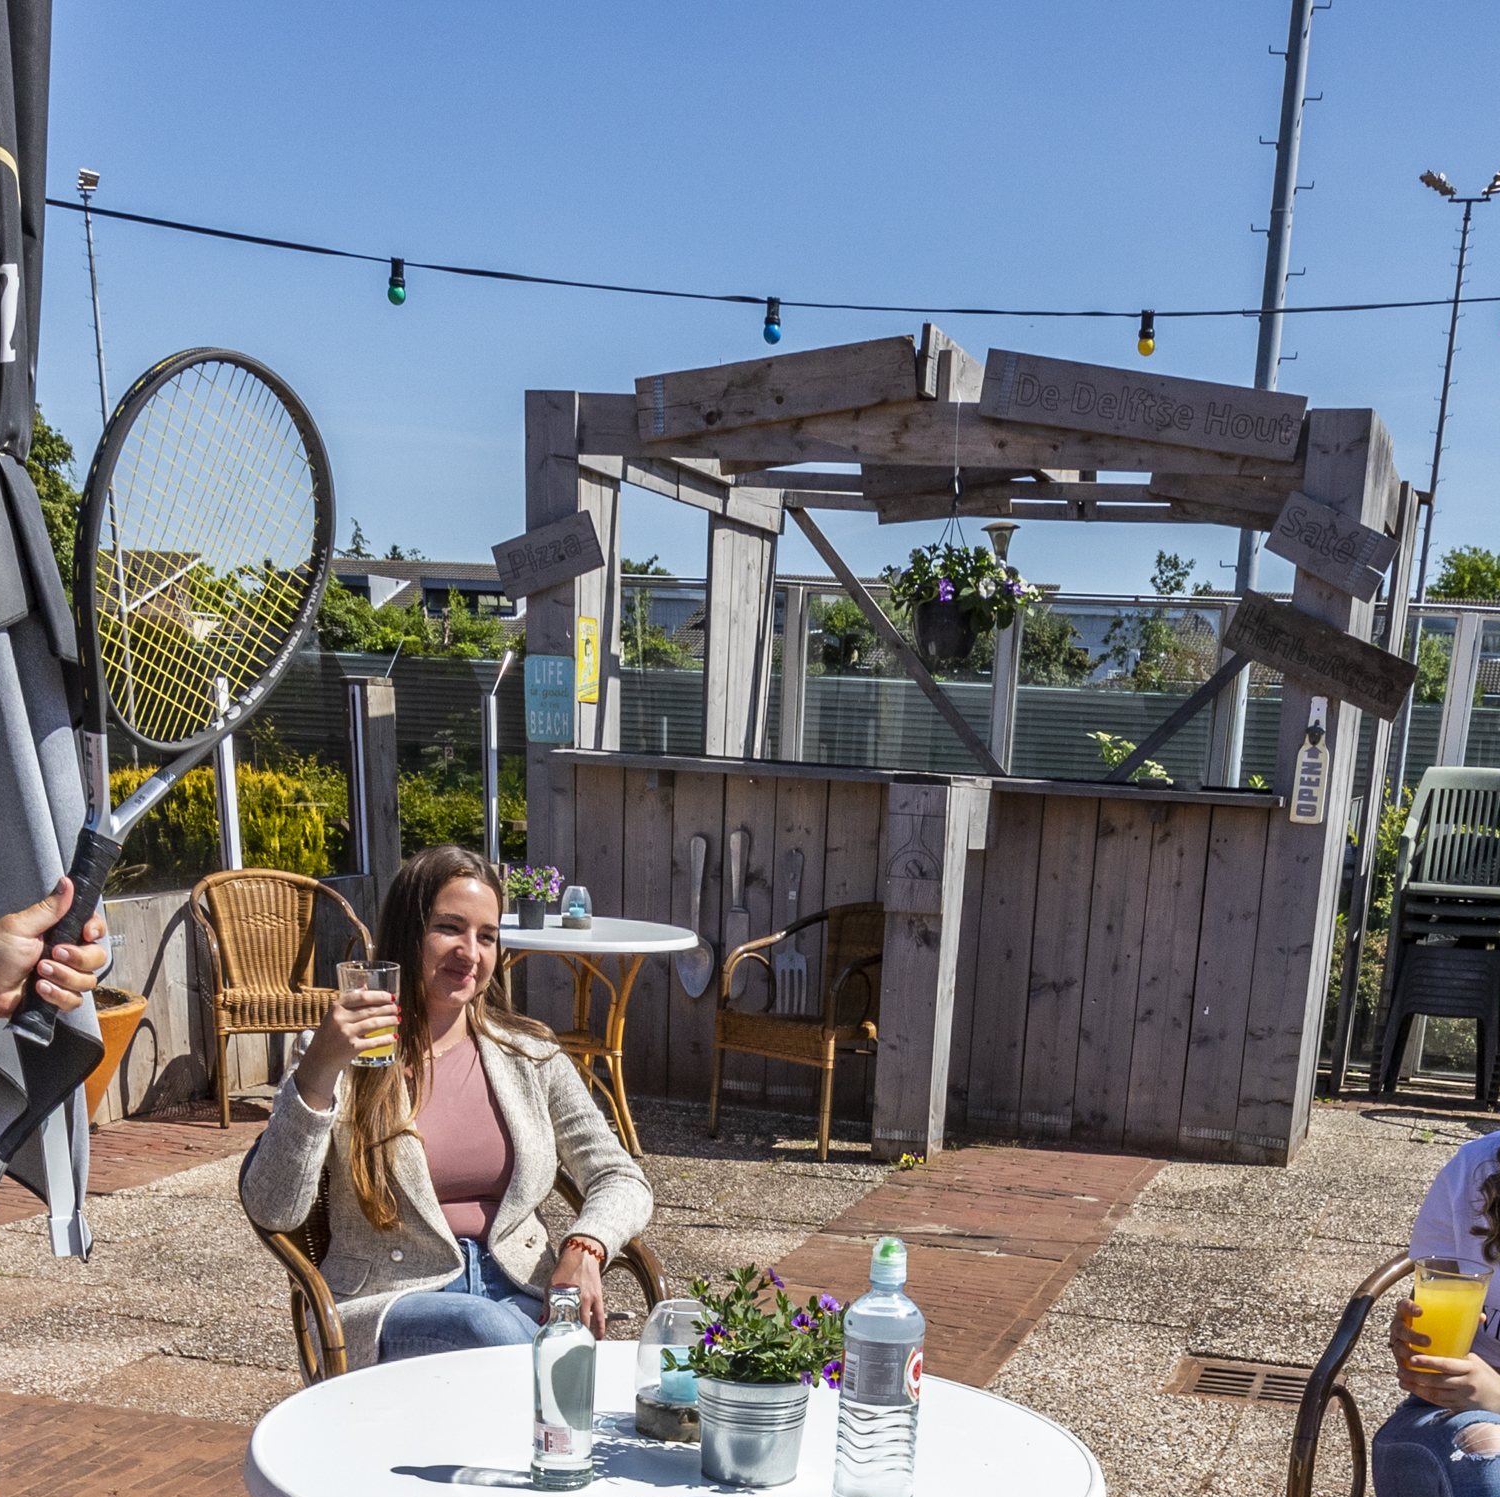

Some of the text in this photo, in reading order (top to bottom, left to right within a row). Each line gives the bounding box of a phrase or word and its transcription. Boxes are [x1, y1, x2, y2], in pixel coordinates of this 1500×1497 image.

[1015, 372, 1294, 446] De Delftse Hout
[507, 533, 583, 580] Pizza
[1279, 505, 1360, 565] Saté
[268, 546, 328, 679] TITANIUM TENNIS
[534, 660, 564, 686] LIFE
[542, 688, 569, 700] good
[530, 710, 569, 736] BEACH
[1295, 761, 1323, 817] OPEN
